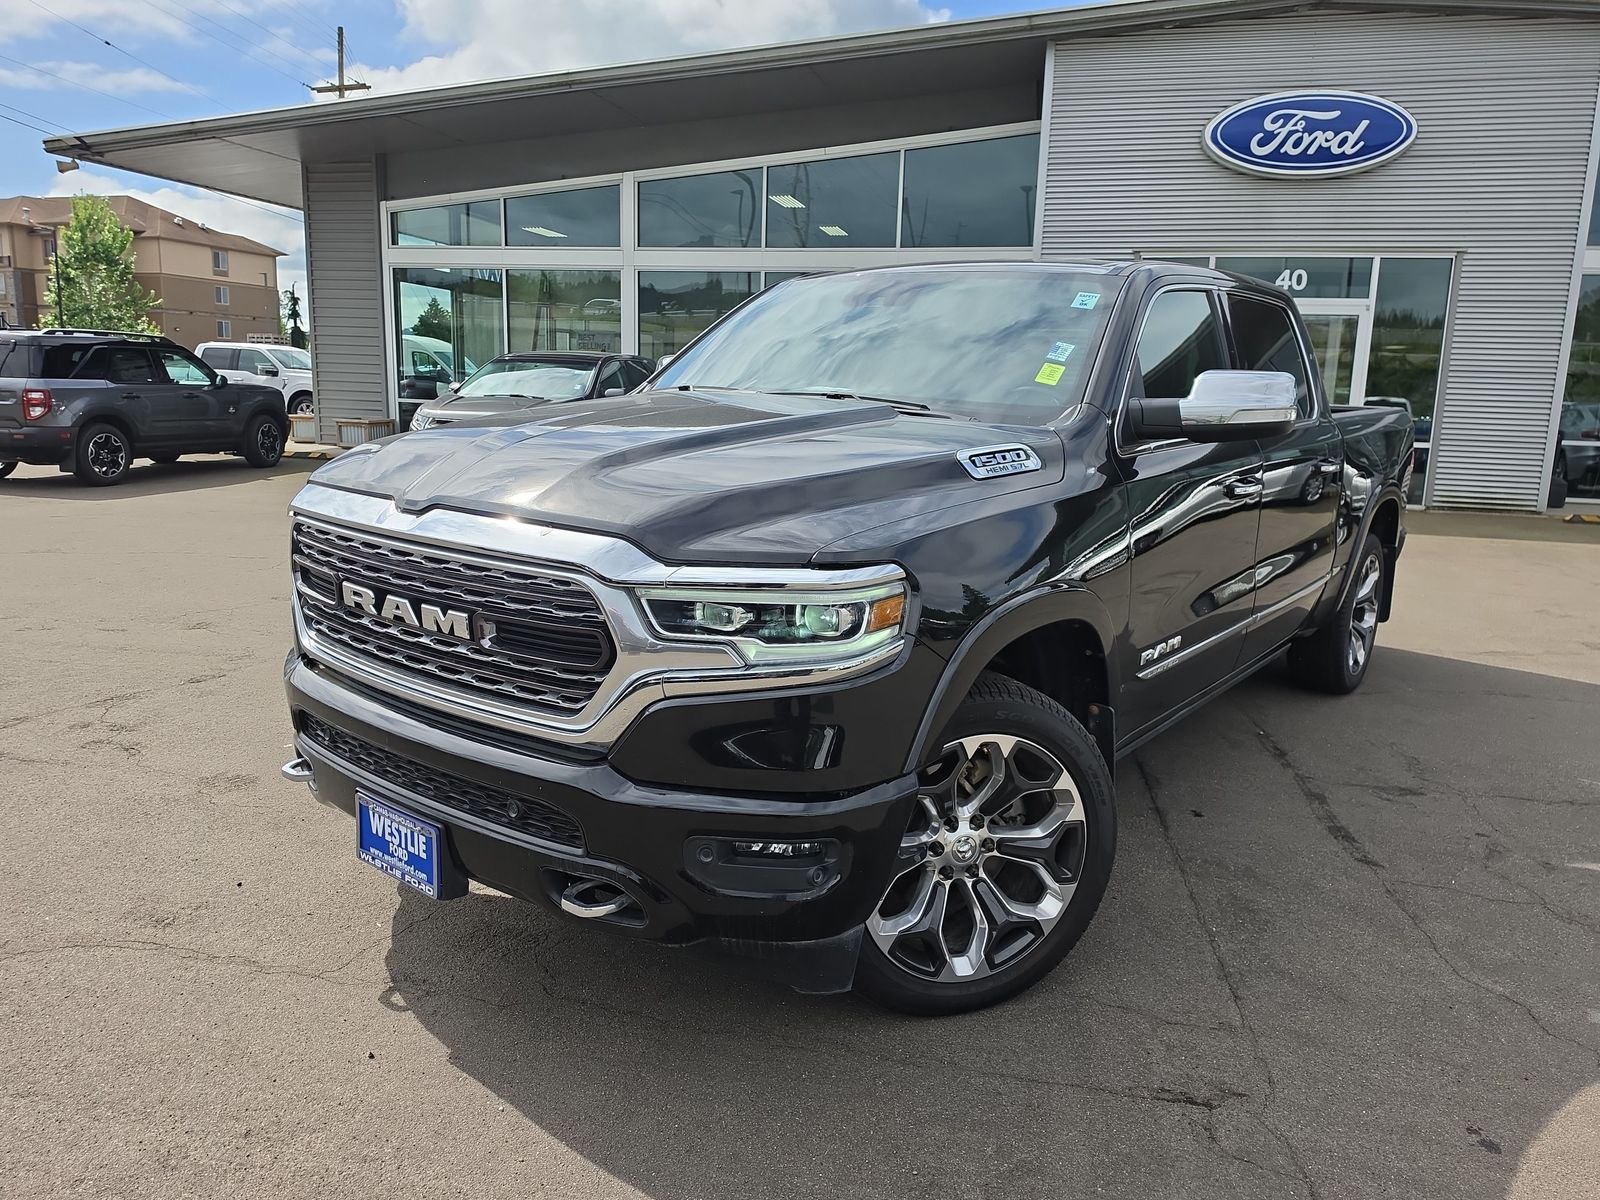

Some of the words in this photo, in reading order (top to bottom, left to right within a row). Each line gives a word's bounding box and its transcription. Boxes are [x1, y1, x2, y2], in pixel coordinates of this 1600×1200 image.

[1250, 109, 1370, 156] Ford
[1275, 269, 1308, 291] 40
[971, 450, 1026, 467] 1500
[985, 466, 1010, 474] HEMI
[1010, 461, 1030, 470] 5.7L
[342, 580, 470, 639] RAM
[1140, 635, 1182, 666] RAM
[369, 809, 427, 860] WESTLIE
[389, 842, 409, 862] FORD
[360, 850, 402, 879] WESTLIE
[404, 873, 434, 896] FORD
